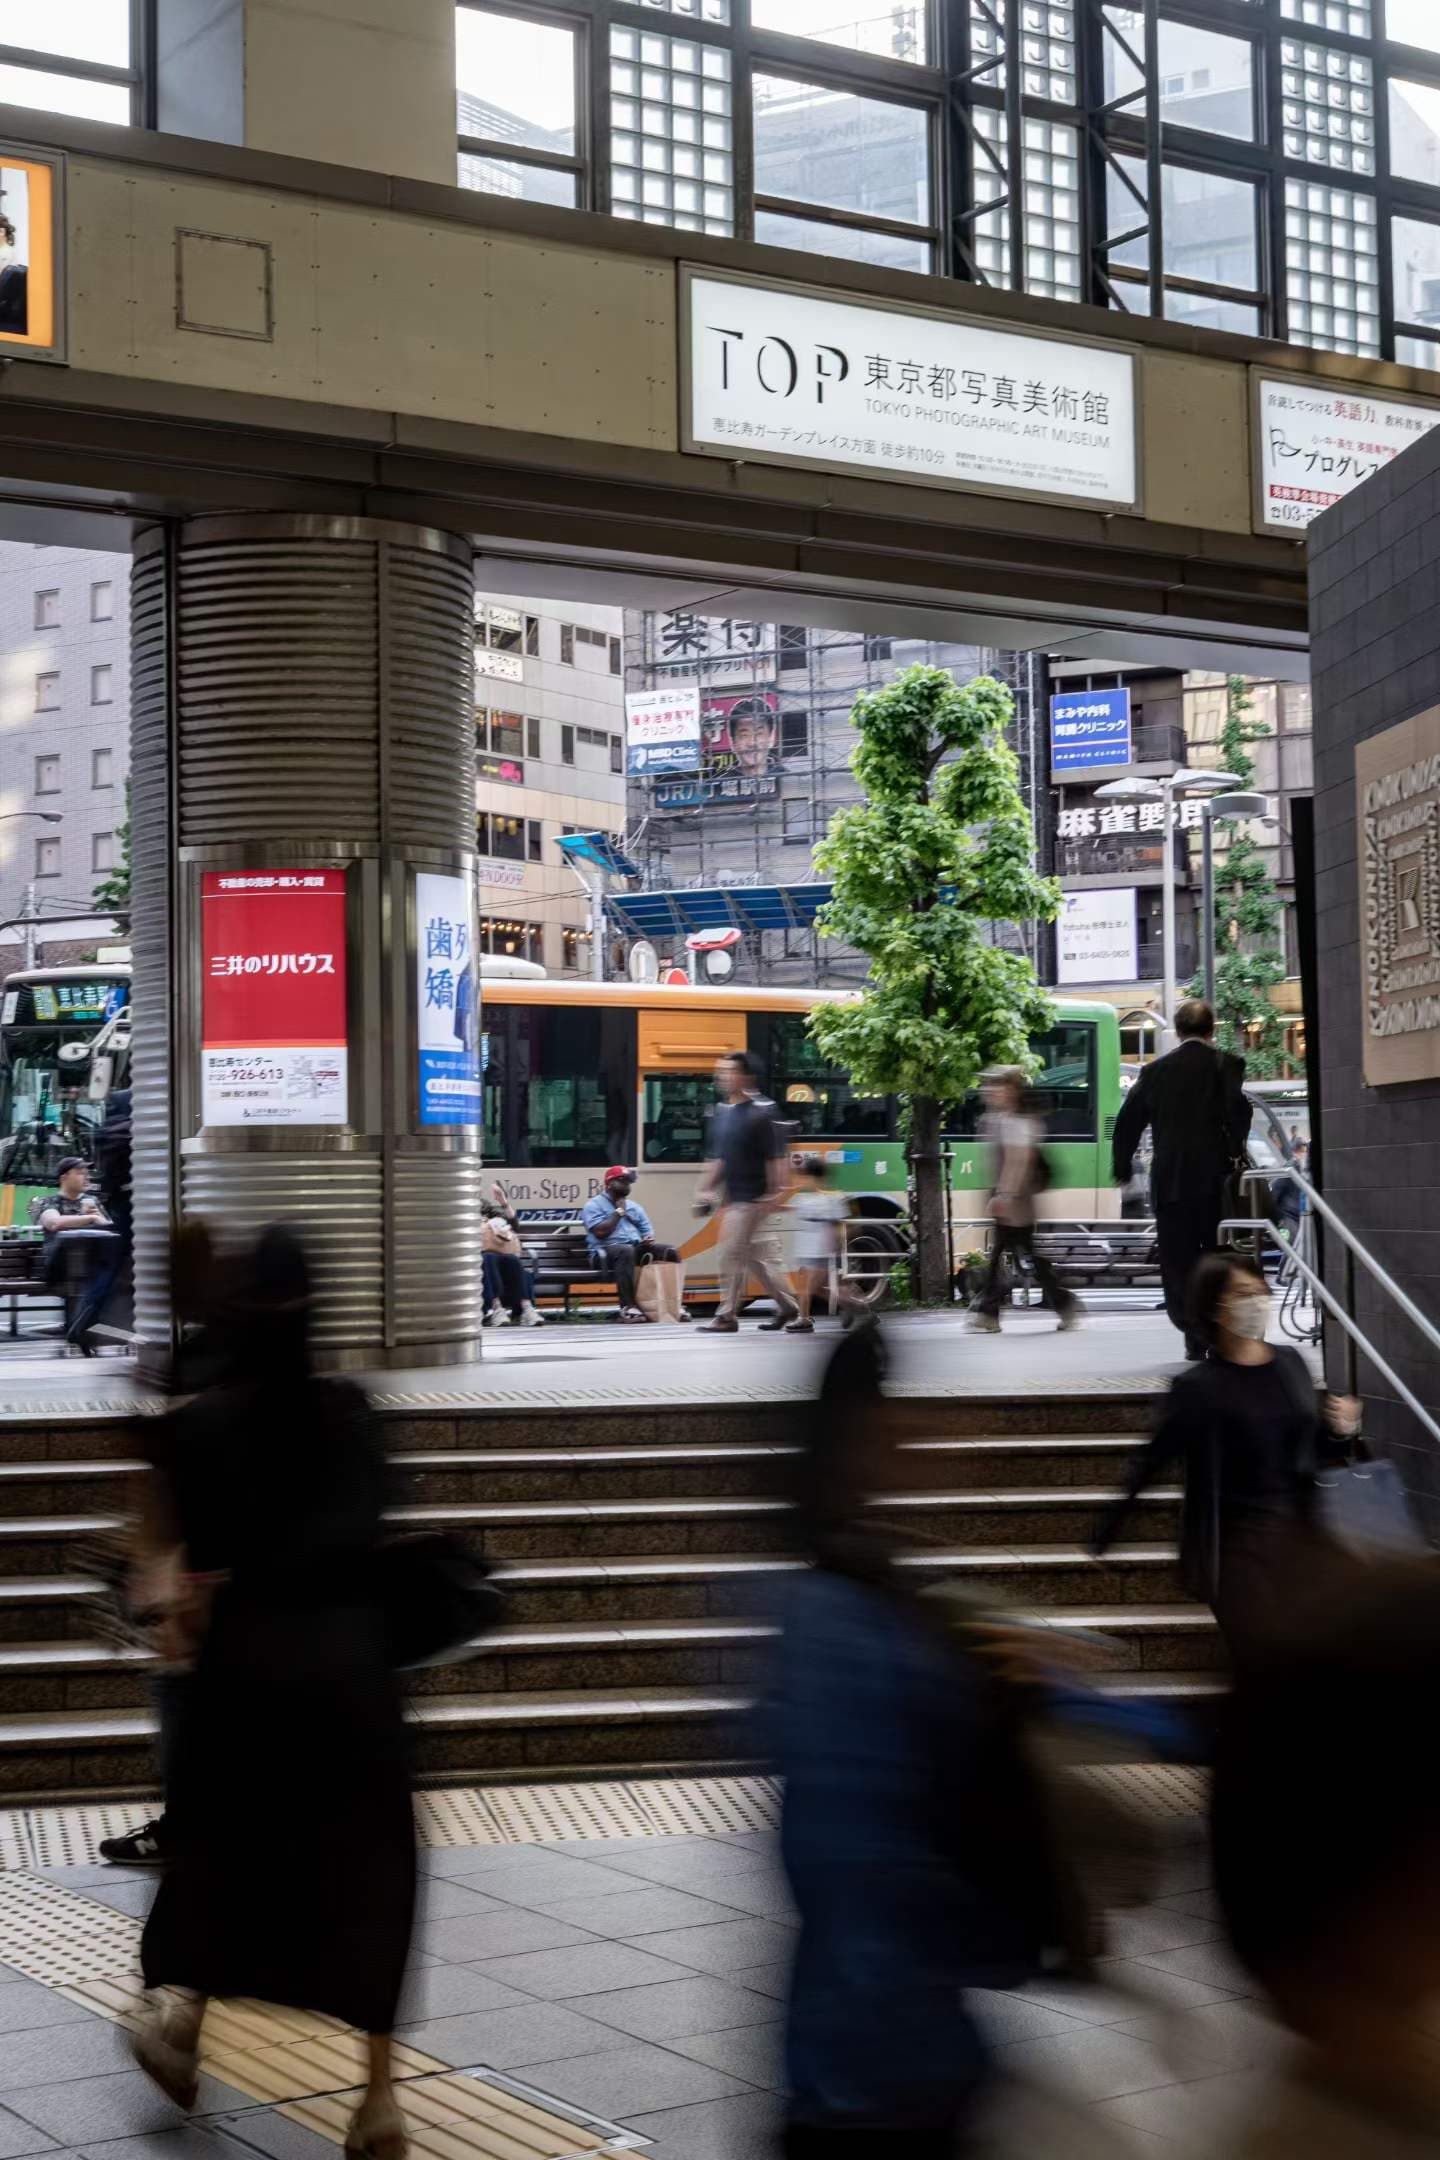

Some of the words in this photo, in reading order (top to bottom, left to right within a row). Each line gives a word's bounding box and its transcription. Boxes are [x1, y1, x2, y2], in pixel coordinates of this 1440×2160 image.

[705, 326, 850, 404] TOP
[863, 354, 1110, 426] 東京都写真美術館
[865, 398, 910, 419] TOKYO
[915, 406, 1019, 435] PHOTOGRAPHIC
[1022, 422, 1048, 440] ART
[1051, 426, 1110, 449] MUSEUM
[880, 441, 945, 465] 徒歩約10分
[210, 954, 335, 977] 三井のリハウス
